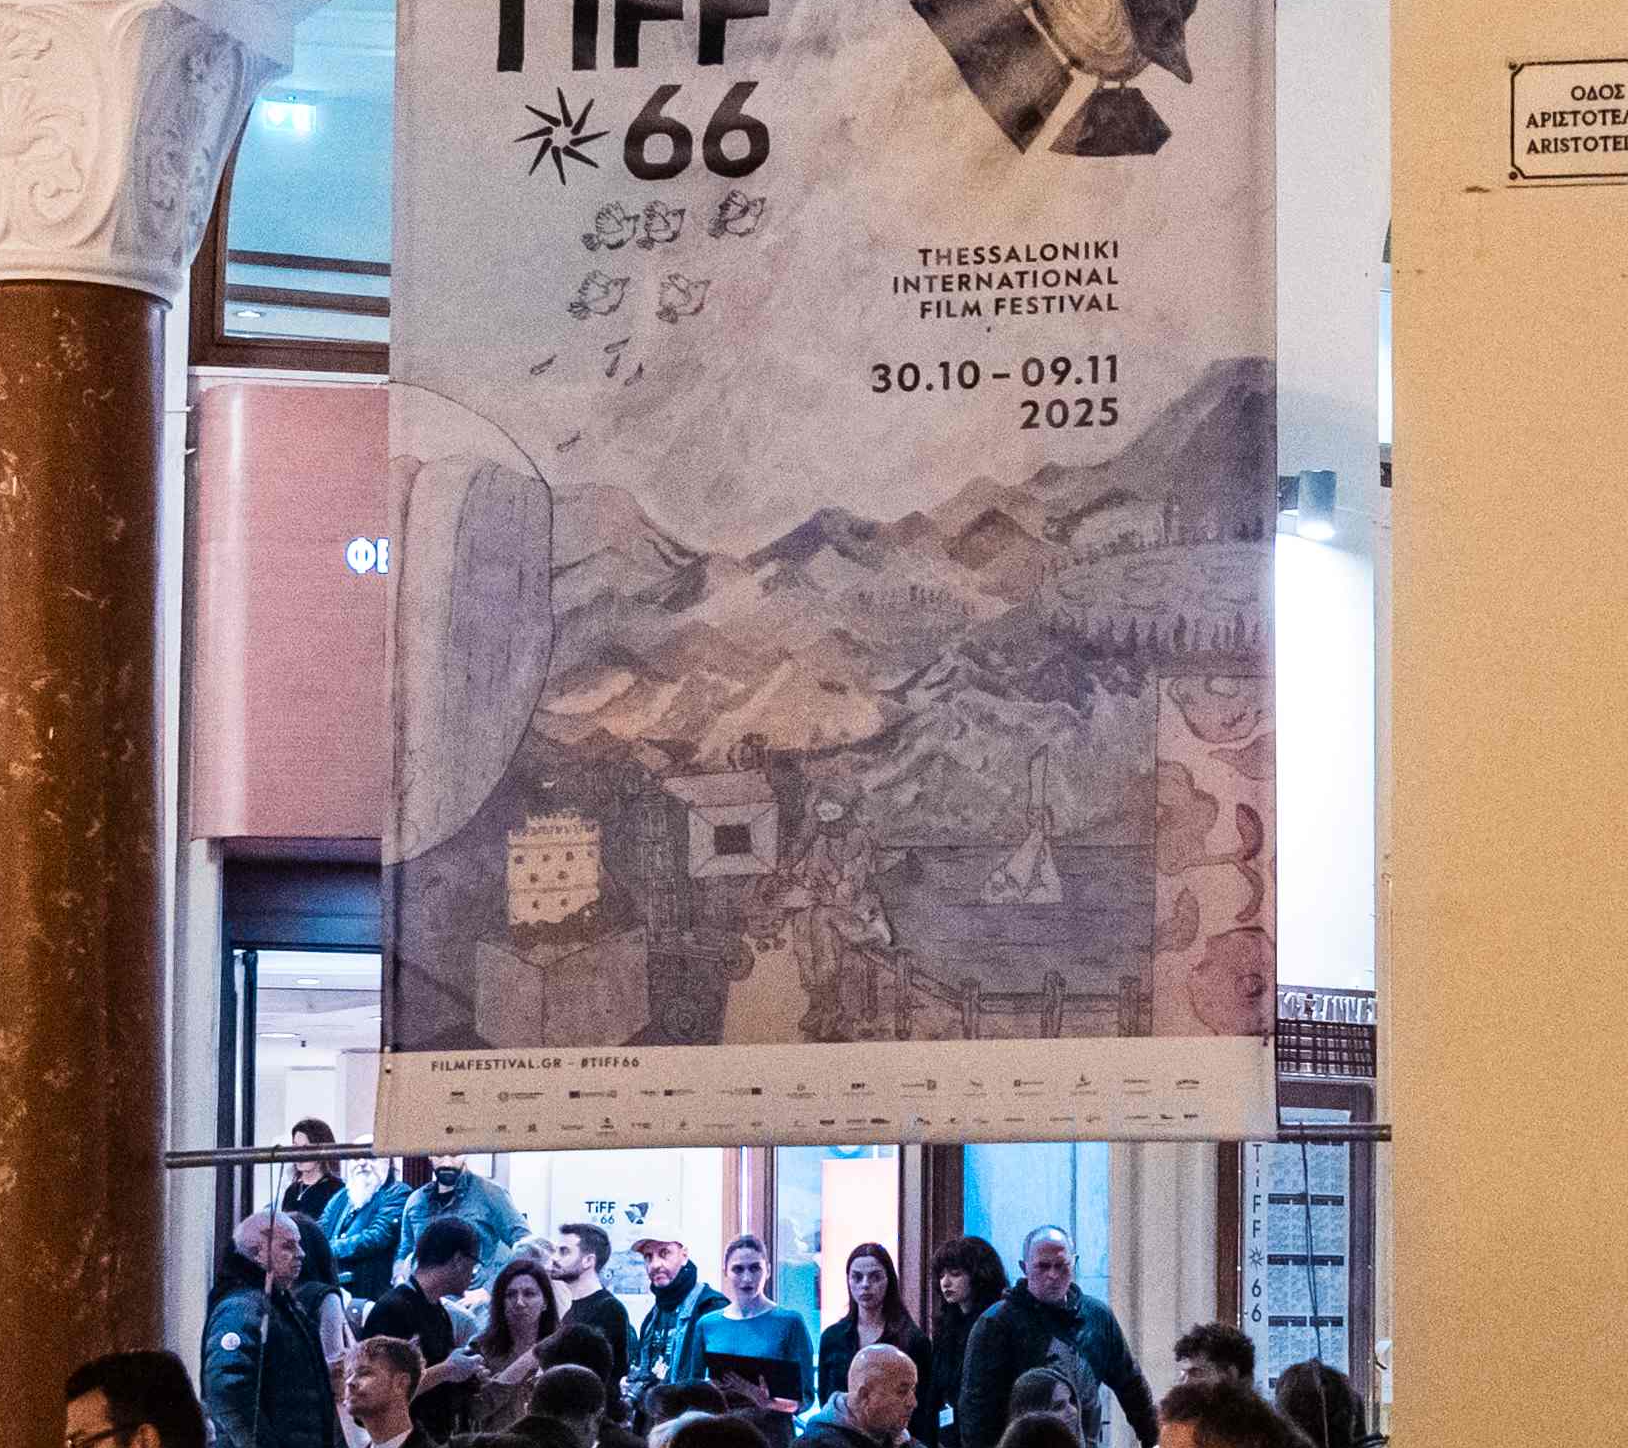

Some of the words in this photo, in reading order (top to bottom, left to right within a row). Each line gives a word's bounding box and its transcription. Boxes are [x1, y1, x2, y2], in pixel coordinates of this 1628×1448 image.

[1570, 84, 1625, 101] ΟΔΟΣ
[624, 81, 770, 181] 66
[918, 240, 1119, 267] THESSALONIKI
[893, 266, 1119, 295] INTERNATIONAL
[919, 299, 982, 319] FILM
[995, 293, 1119, 316] FESTIVAL
[872, 359, 980, 393] 30.10
[1022, 354, 1118, 387] 09.11
[1020, 397, 1119, 429] 2025
[431, 1058, 562, 1072] FILMFESTIVAL.GR
